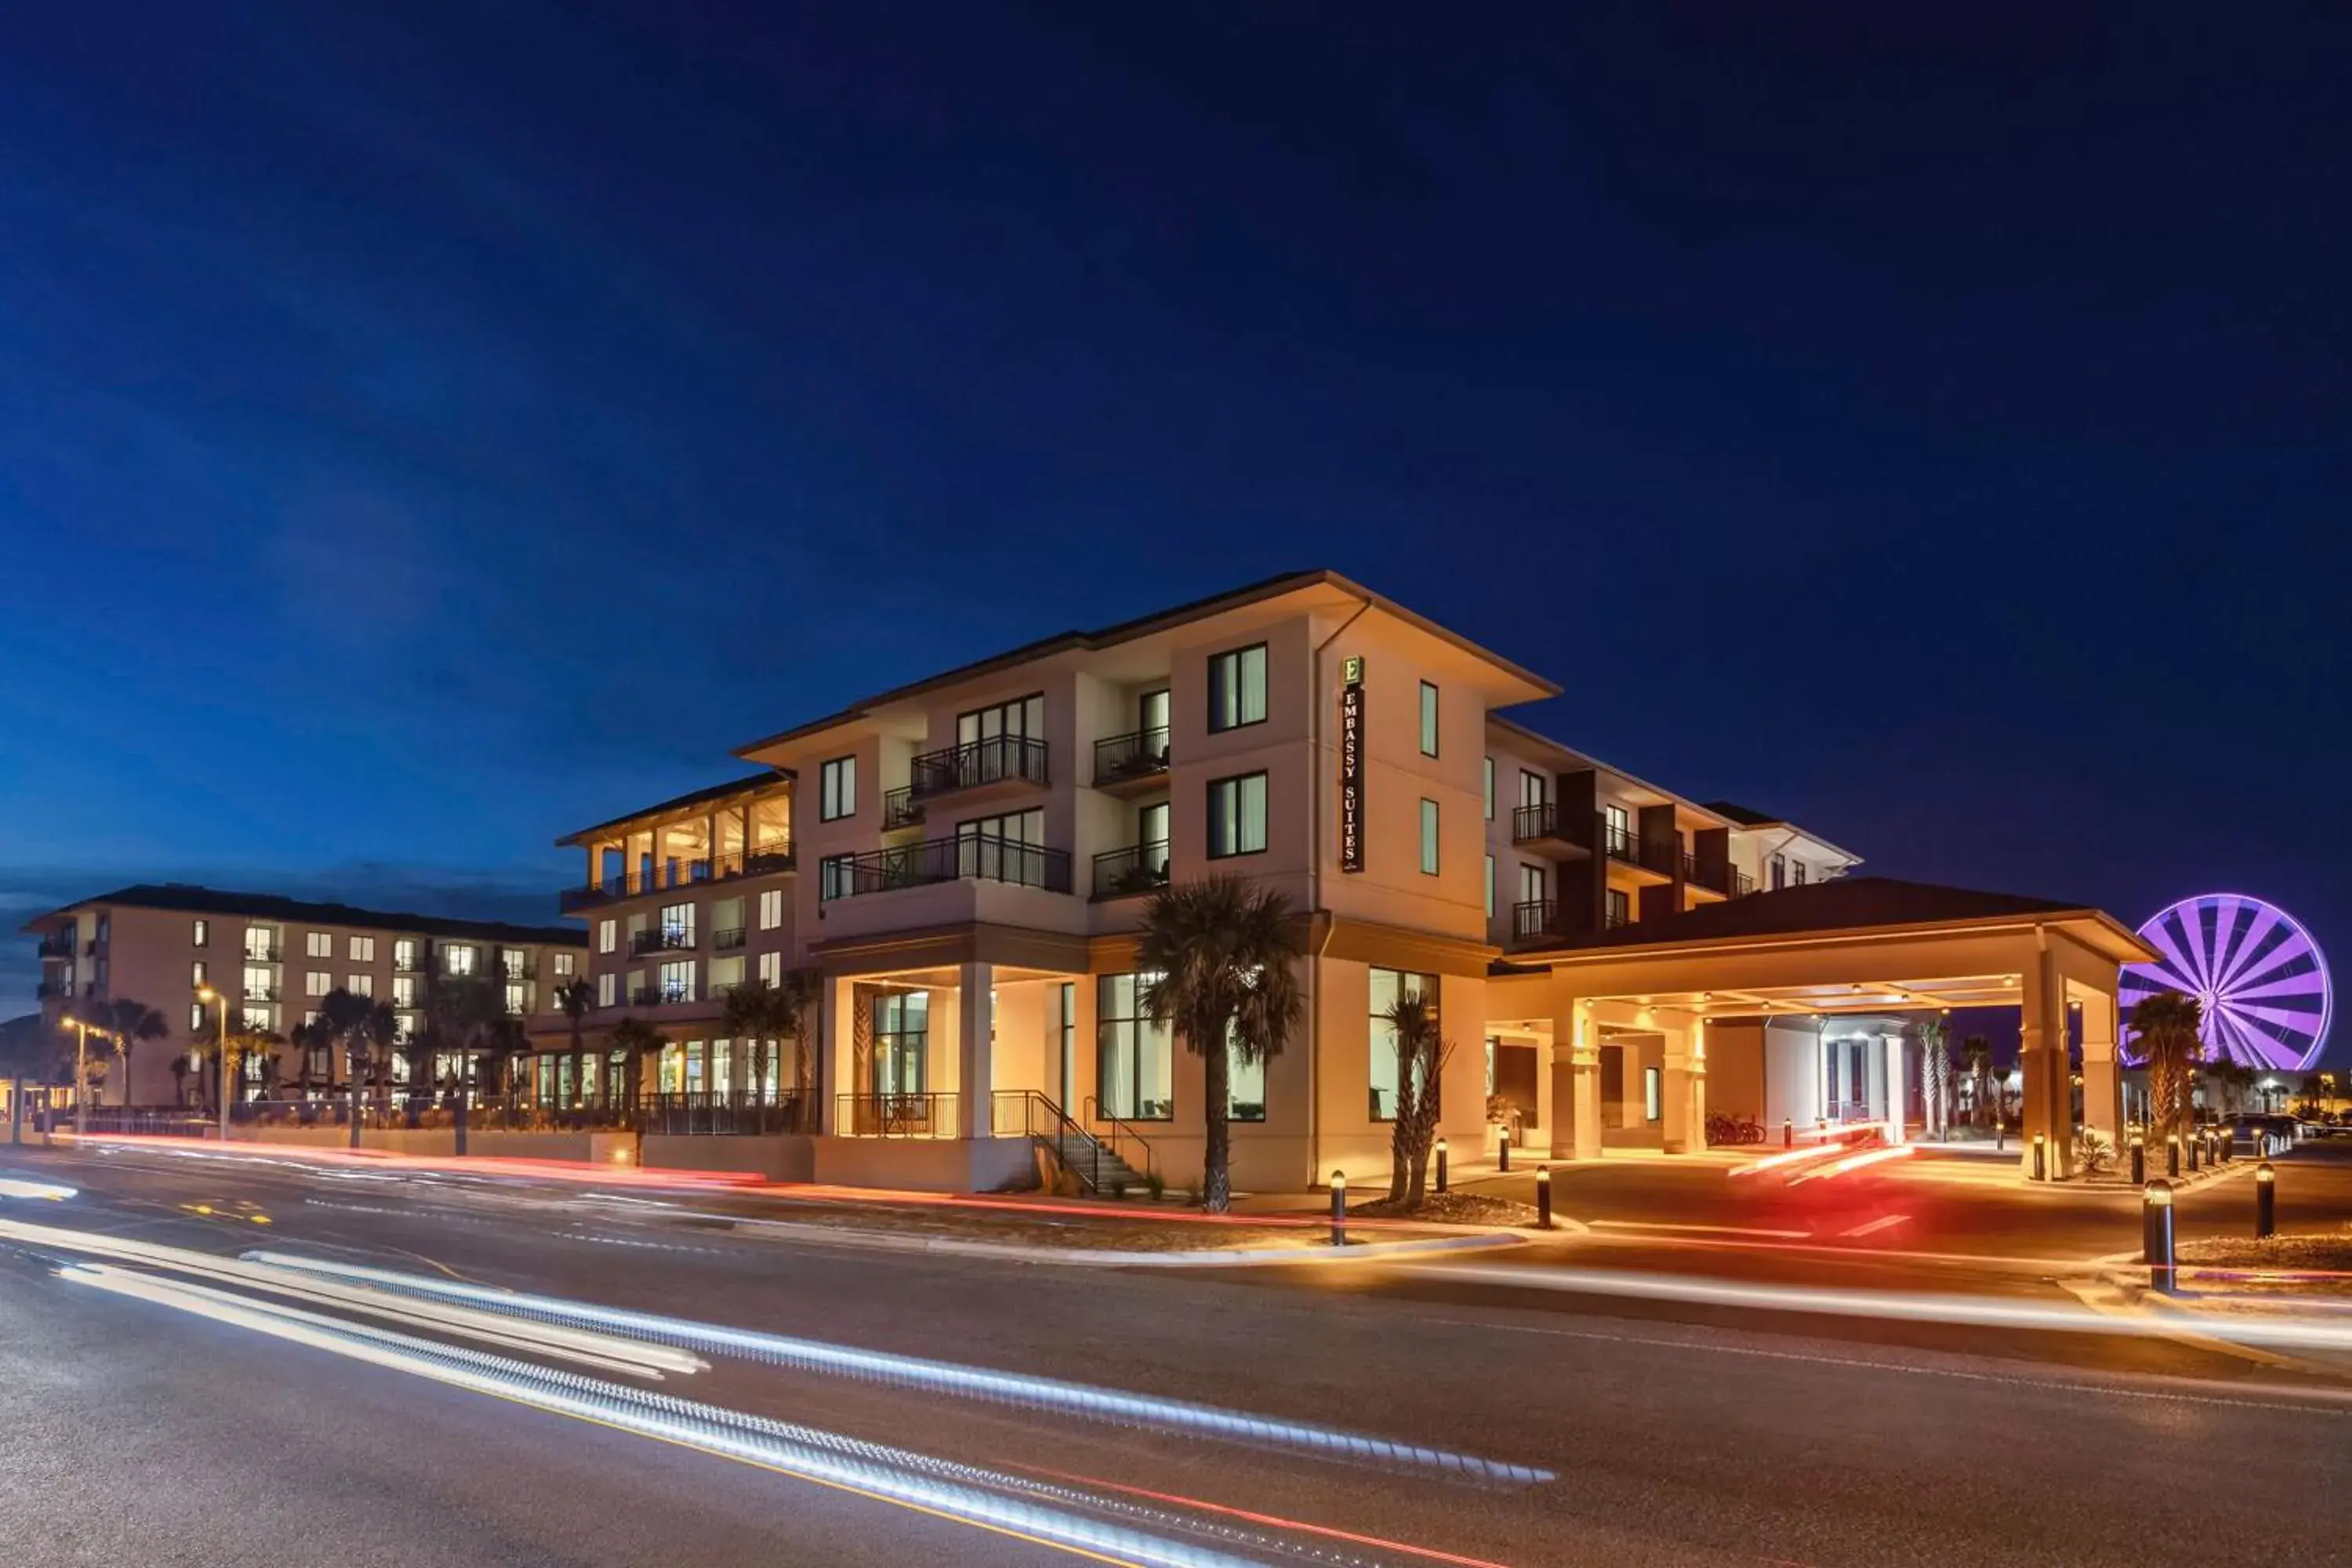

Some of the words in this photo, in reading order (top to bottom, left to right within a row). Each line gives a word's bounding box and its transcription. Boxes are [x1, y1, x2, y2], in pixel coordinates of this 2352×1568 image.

[1345, 660, 1358, 681] E
[1344, 693, 1357, 778] EMBASSY
[1345, 786, 1356, 859] SUITES
